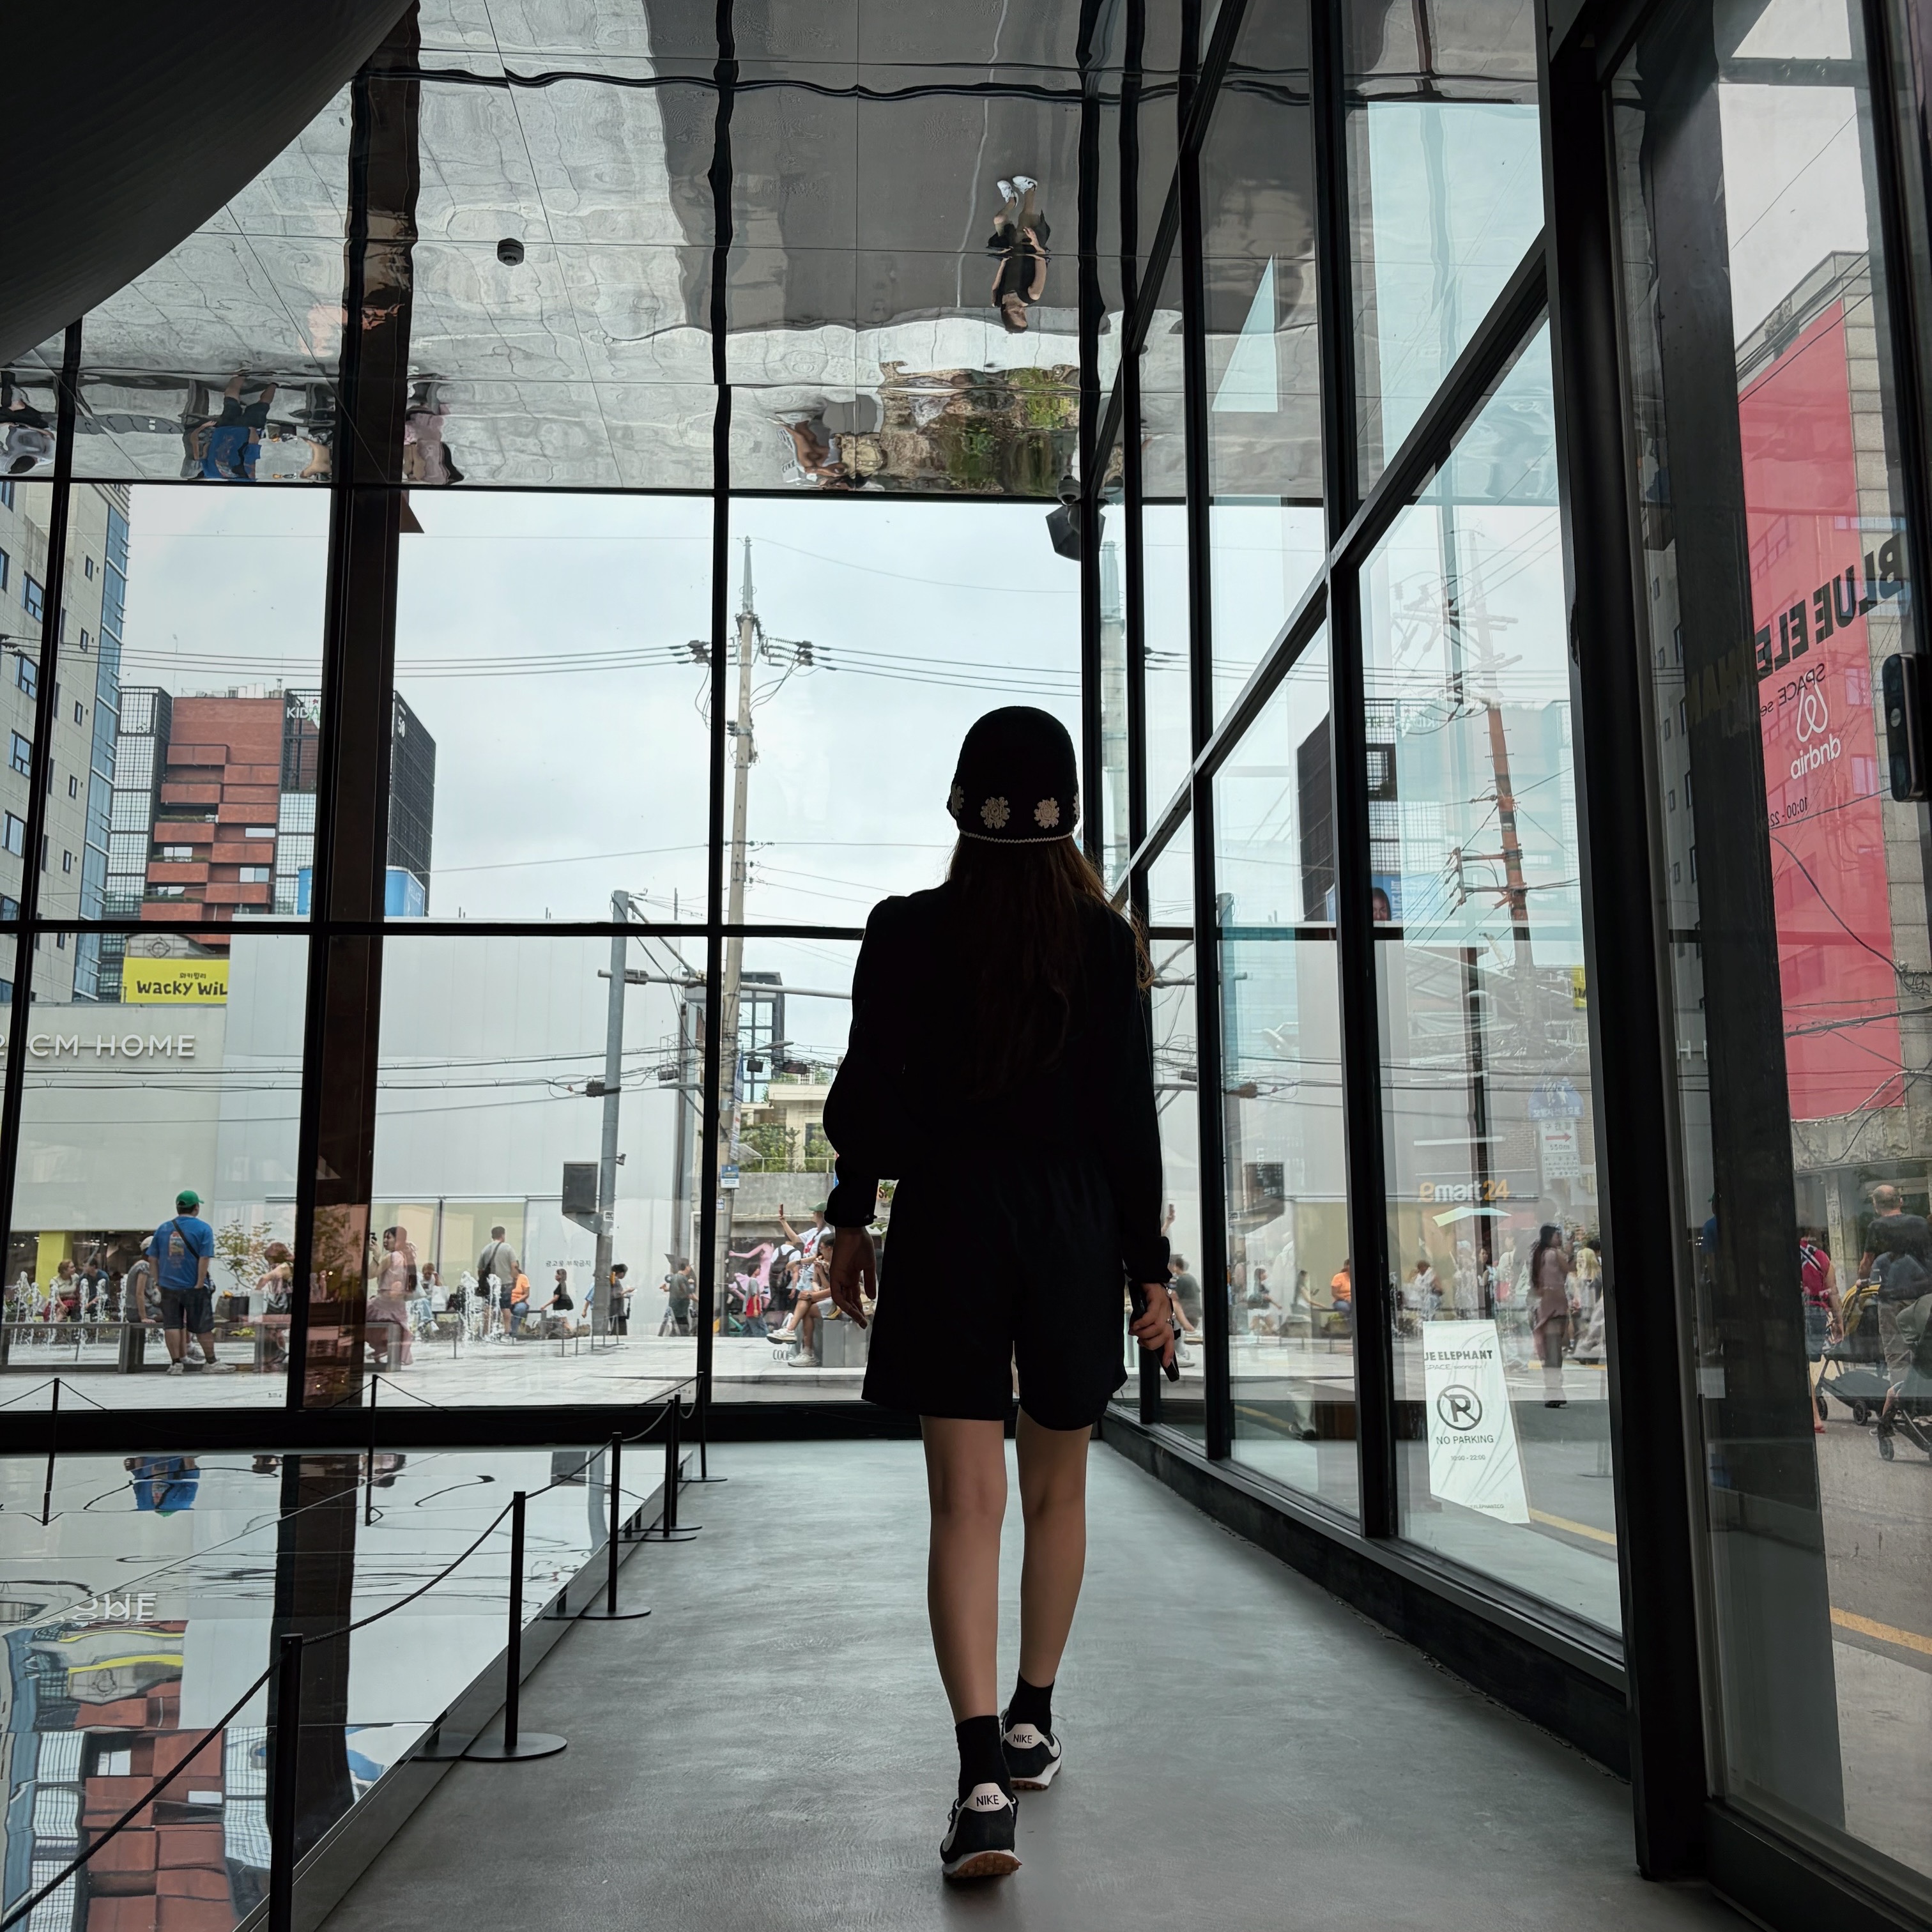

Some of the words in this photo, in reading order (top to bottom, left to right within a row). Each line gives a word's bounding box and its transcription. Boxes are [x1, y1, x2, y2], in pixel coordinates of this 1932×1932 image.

[1791, 733, 1841, 779] airbnb
[96, 1034, 195, 1057] HOME
[1438, 1350, 1493, 1361] ELEPHANT
[1436, 1436, 1451, 1445] NO
[1453, 1435, 1494, 1444] PARKING
[1013, 1733, 1032, 1744] NIKE
[976, 1794, 999, 1807] NIKE
